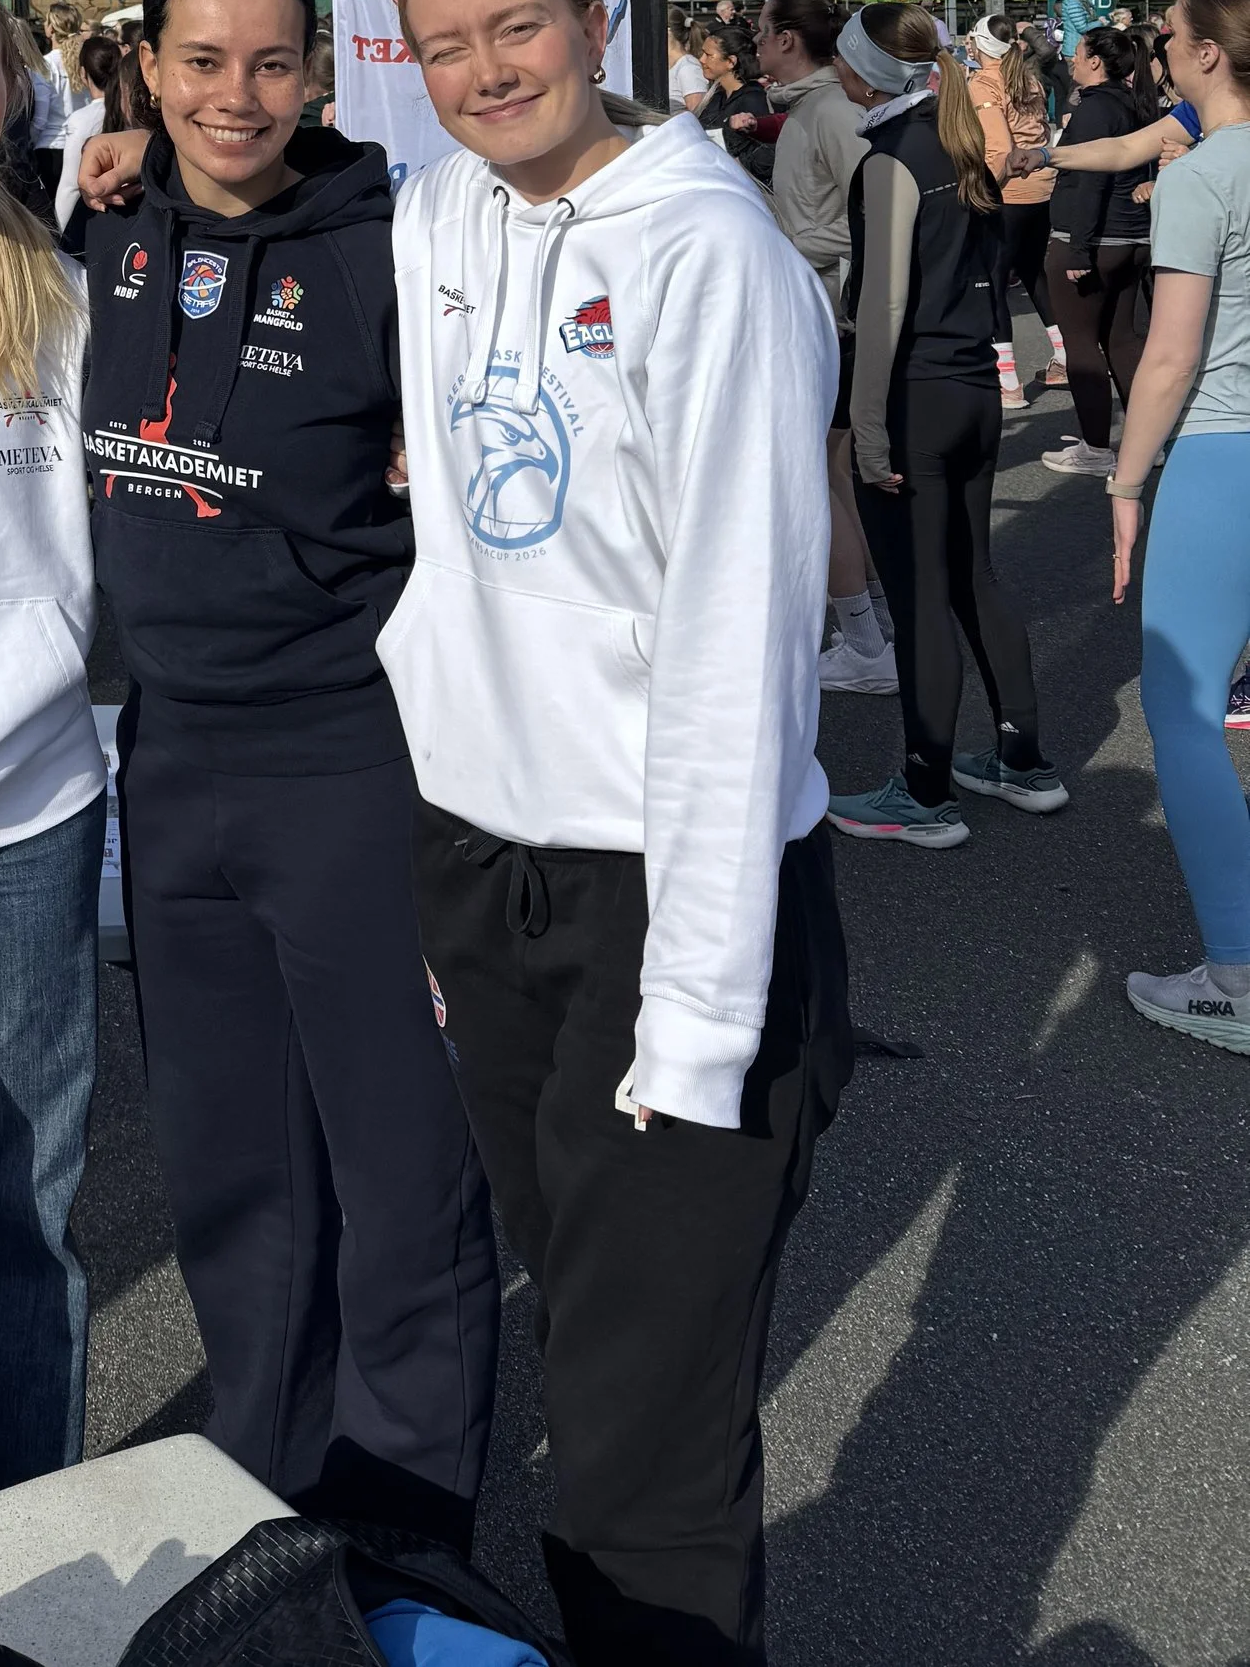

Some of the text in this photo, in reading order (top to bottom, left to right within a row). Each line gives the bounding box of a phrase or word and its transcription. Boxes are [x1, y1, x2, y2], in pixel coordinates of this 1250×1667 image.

[265, 308, 291, 319] BASKET
[253, 314, 304, 331] MANGFOLD
[562, 322, 614, 349] EAGL
[256, 363, 269, 371] OG
[268, 366, 293, 377] HELSE
[491, 350, 522, 363] ASK
[540, 366, 584, 437] ESTIVAL
[7, 466, 26, 475] SPORT
[35, 464, 54, 473] HELSE
[127, 483, 183, 499] BERGEN
[471, 538, 510, 561] ANSACUP
[1188, 999, 1236, 1017] HOKA
